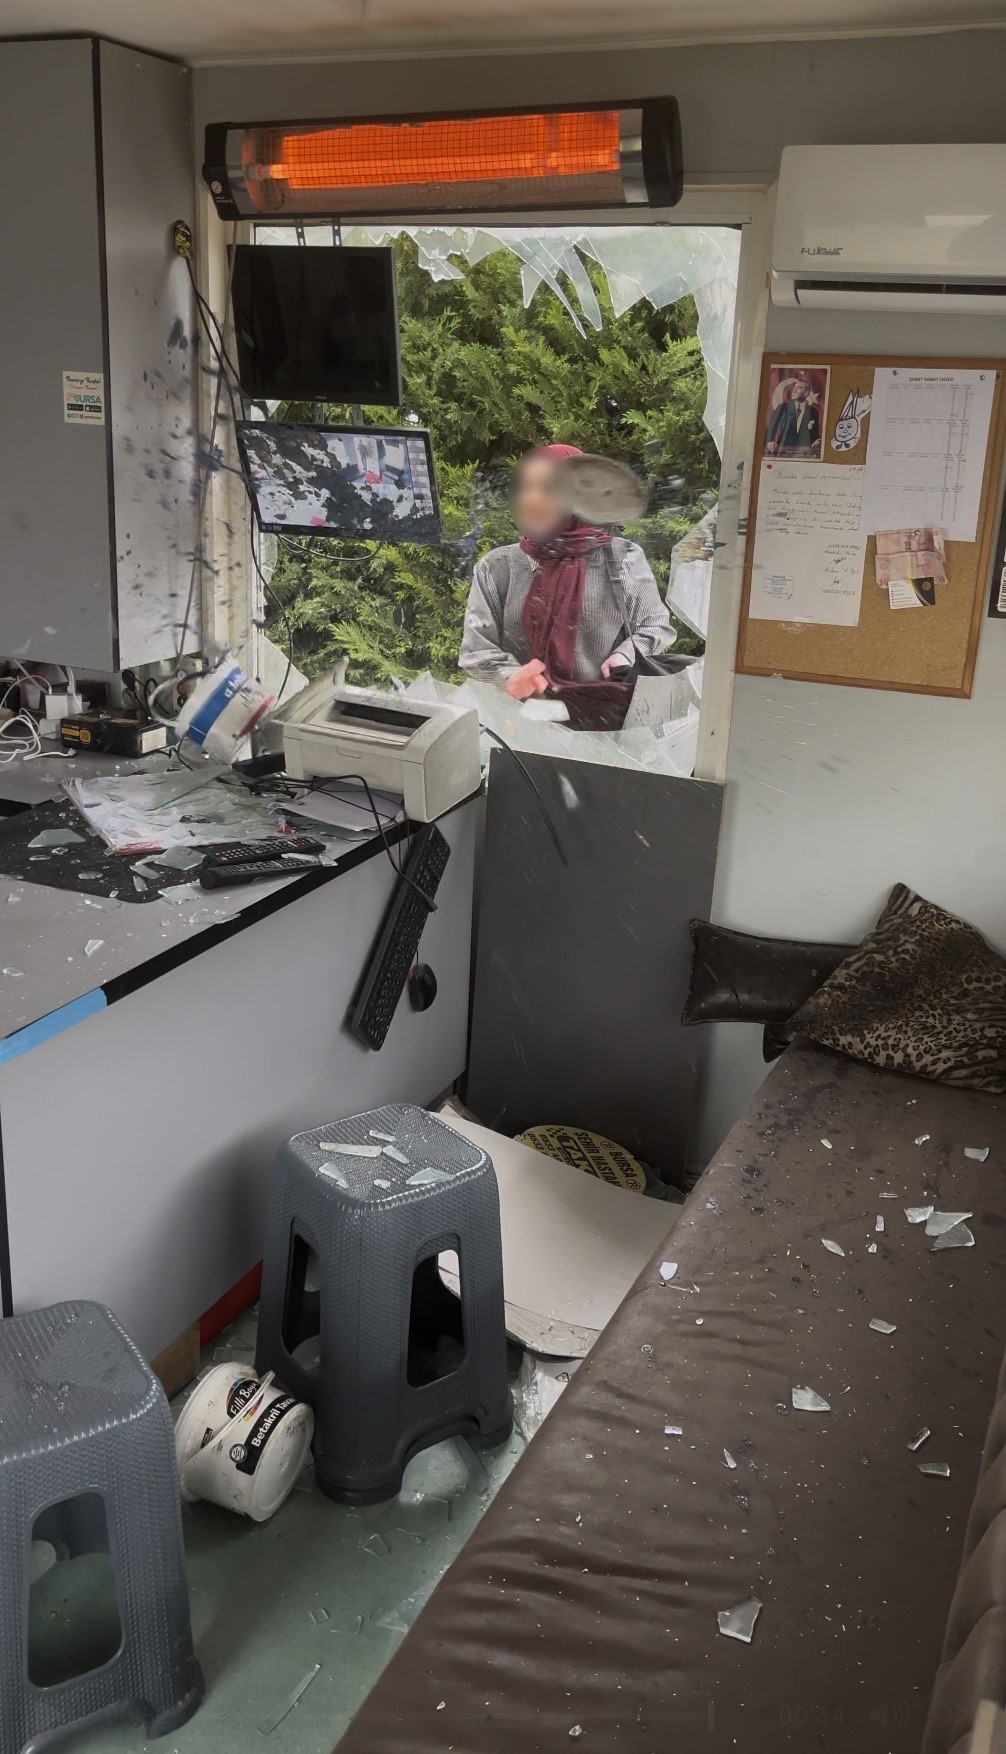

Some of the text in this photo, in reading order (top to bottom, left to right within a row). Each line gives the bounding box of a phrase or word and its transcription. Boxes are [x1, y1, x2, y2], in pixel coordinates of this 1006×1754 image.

[609, 1151, 638, 1177] BURSA
[230, 1397, 246, 1415] Filli
[251, 1408, 281, 1447] Betakril
